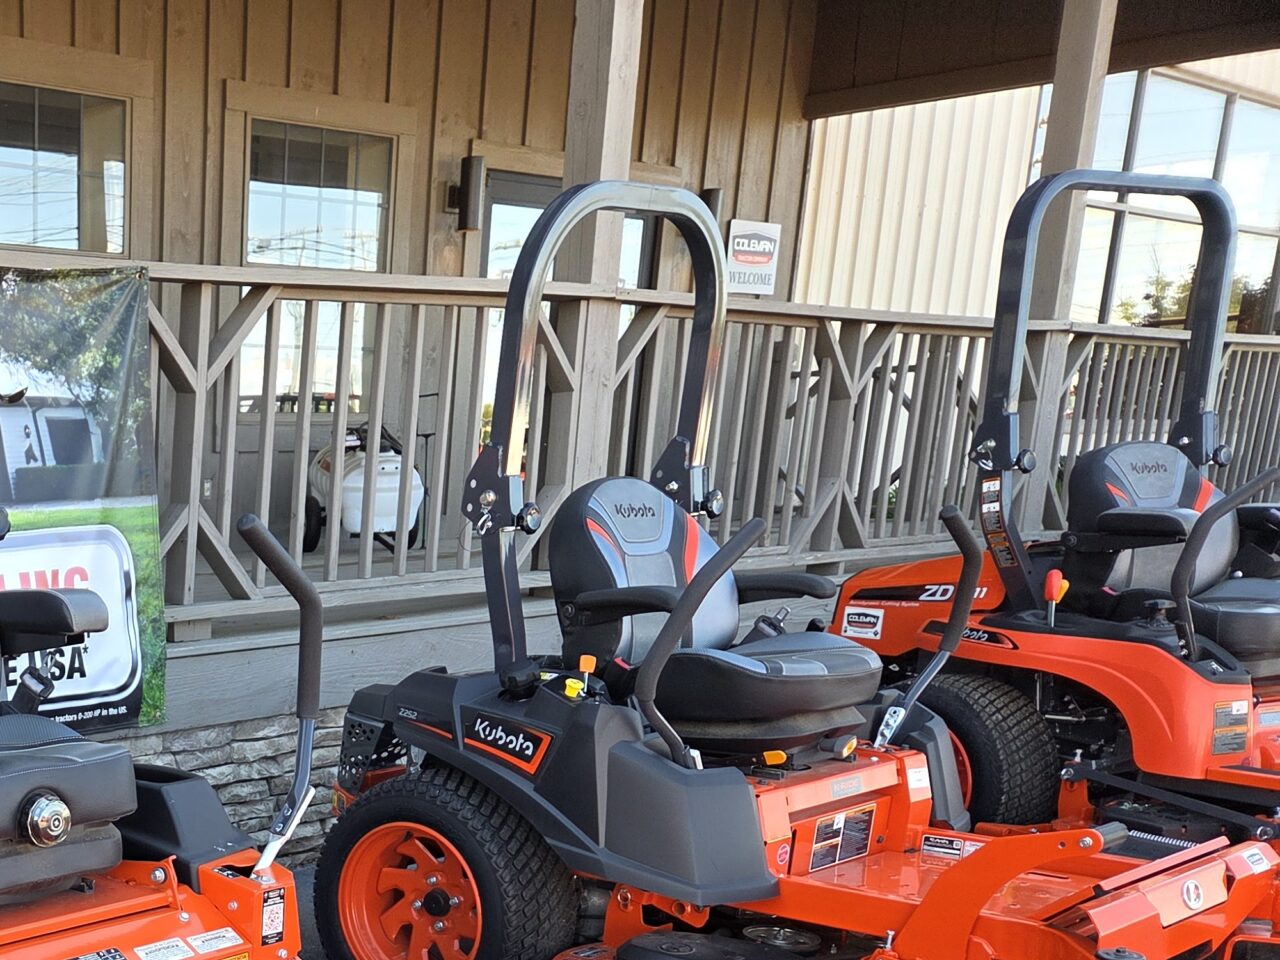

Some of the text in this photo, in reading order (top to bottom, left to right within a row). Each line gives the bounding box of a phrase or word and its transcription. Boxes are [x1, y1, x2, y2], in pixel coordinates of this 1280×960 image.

[734, 238, 774, 253] COLEMAN
[729, 271, 773, 286] WELCOME
[1130, 461, 1168, 475] Kubota
[614, 503, 656, 518] Kubota
[848, 614, 878, 624] COLEMAN
[102, 708, 108, 716] in
[109, 707, 118, 716] the
[474, 718, 534, 756] Kubota
